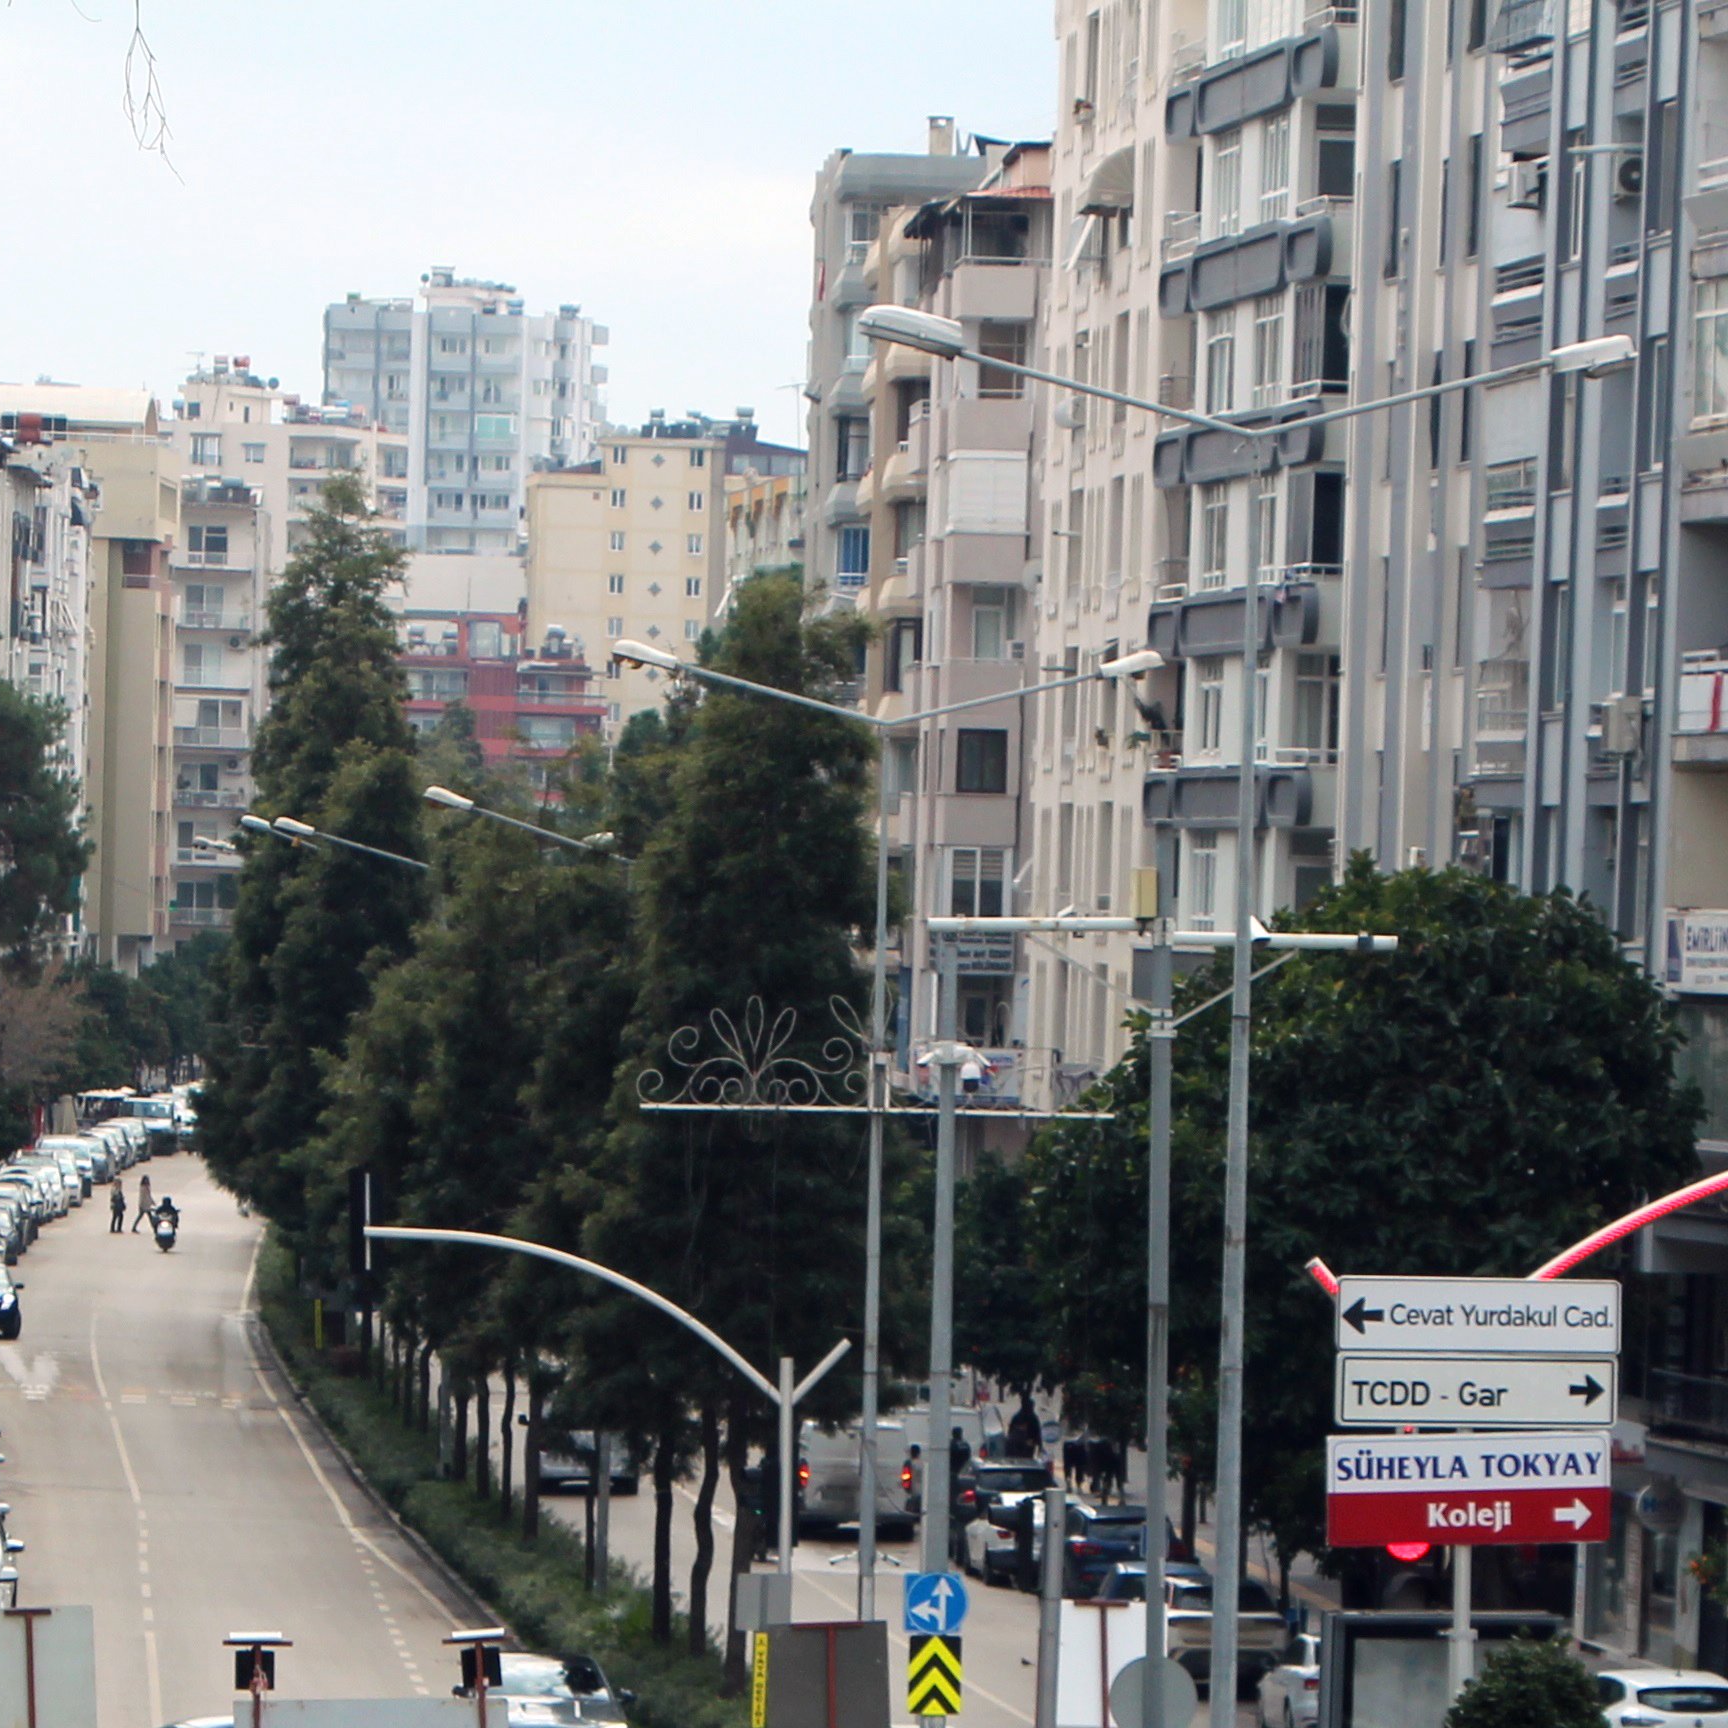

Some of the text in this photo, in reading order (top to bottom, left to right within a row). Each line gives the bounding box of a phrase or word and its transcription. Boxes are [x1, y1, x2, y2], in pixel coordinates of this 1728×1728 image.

[1390, 1303, 1614, 1328] Cevat Yurdakul Cad.
[1351, 1380, 1430, 1406] TCDD
[1459, 1381, 1508, 1407] Gar
[1336, 1449, 1602, 1481] SÜHEYLA TOKYAY
[1426, 1501, 1512, 1533] Koleji
